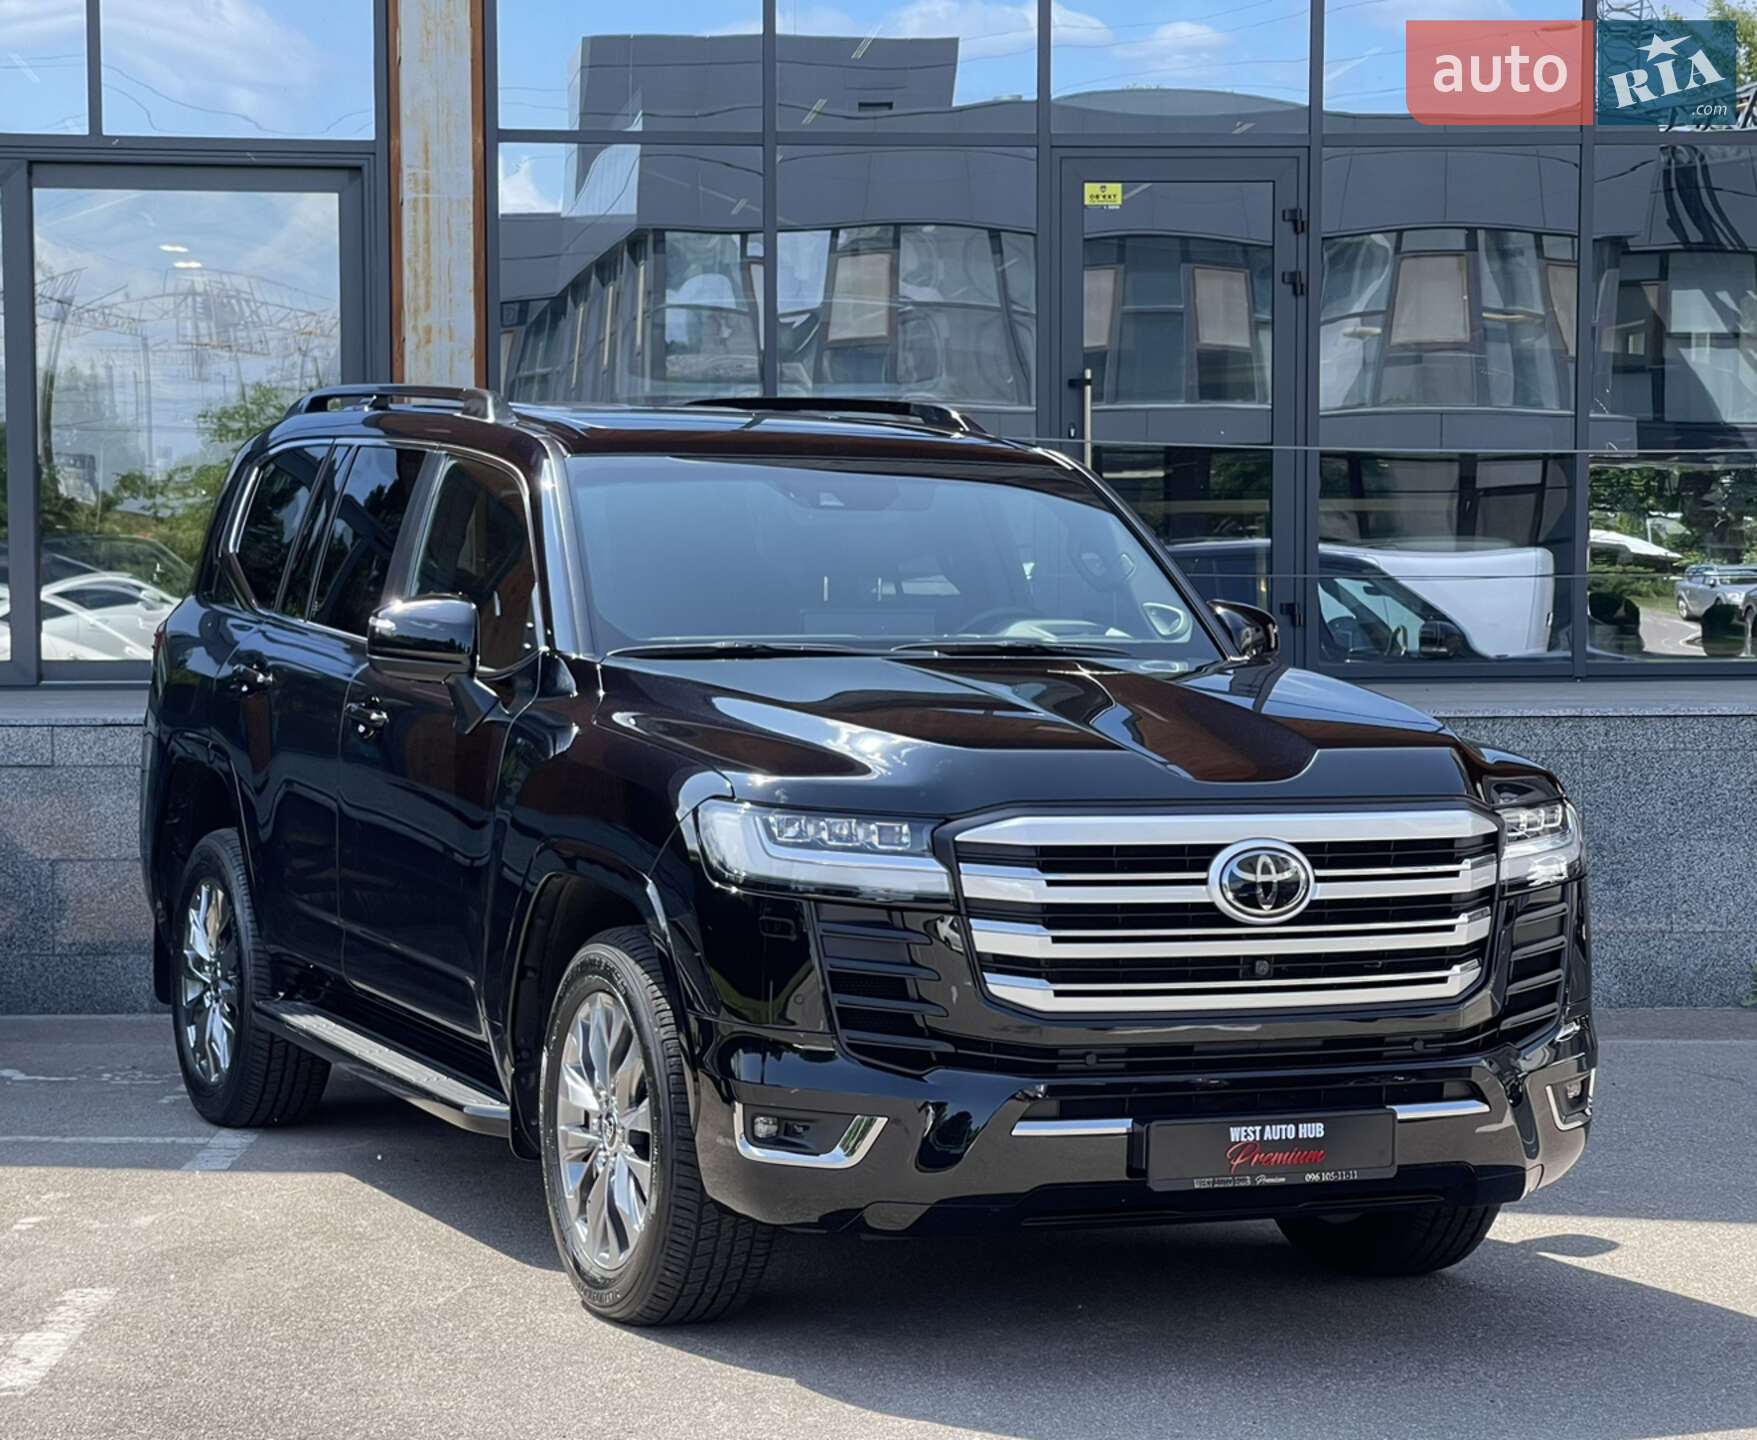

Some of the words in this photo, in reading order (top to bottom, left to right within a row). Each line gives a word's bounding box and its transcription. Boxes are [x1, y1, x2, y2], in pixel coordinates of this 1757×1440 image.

[1229, 1125, 1262, 1142] WEST
[1263, 1124, 1296, 1141] AUTO
[1298, 1122, 1325, 1139] HUB
[1226, 1141, 1326, 1175] Premium
[1305, 1172, 1321, 1183] 096
